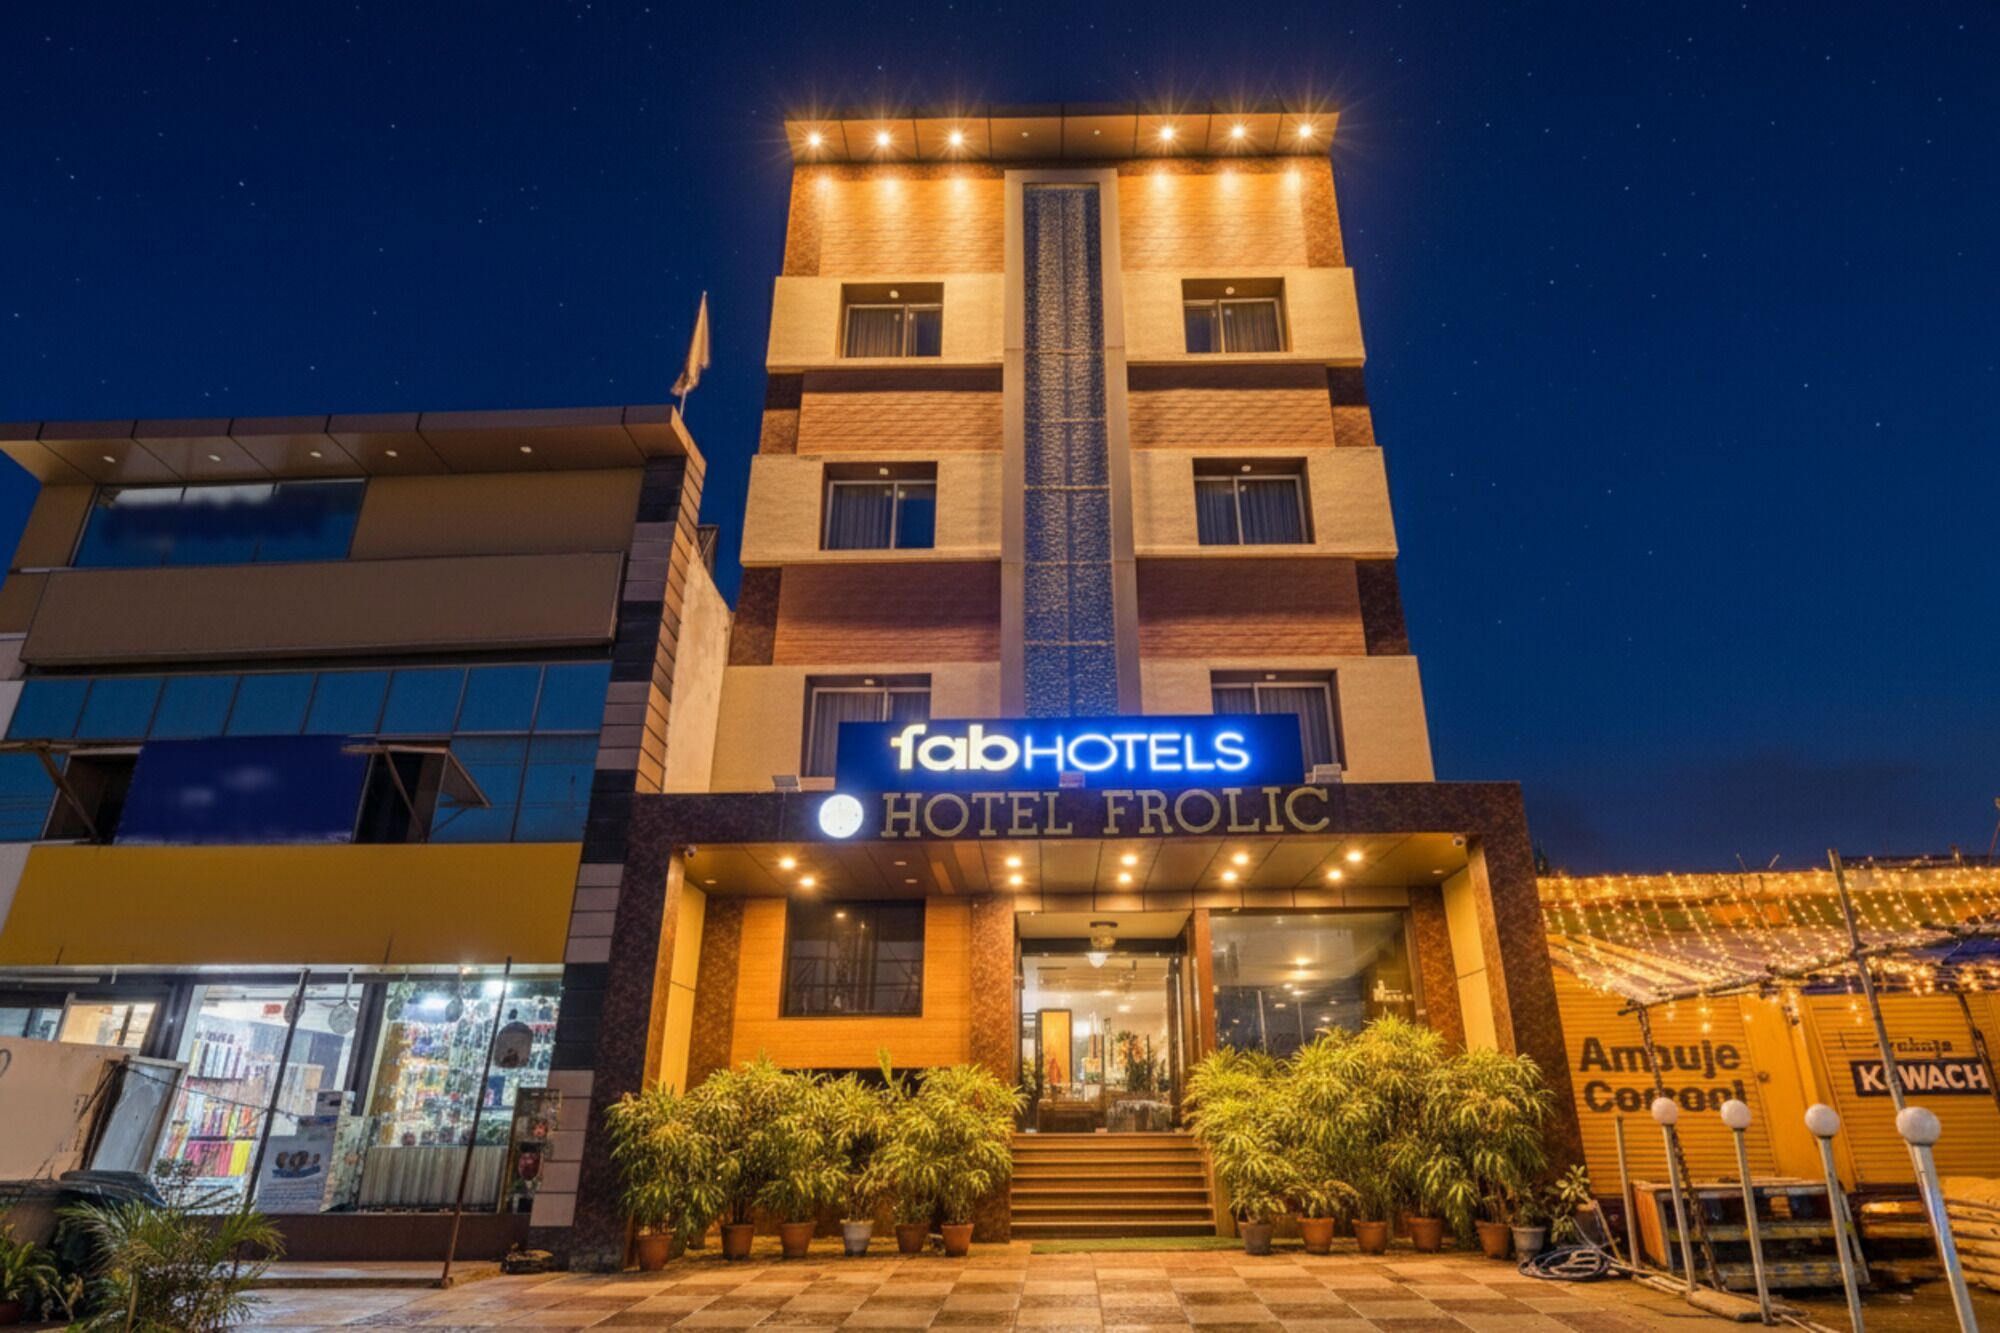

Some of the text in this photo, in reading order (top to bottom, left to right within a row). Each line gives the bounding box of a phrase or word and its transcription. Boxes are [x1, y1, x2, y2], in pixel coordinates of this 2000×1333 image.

[880, 786, 1331, 838] HOTEL FROLIC
[1858, 1063, 1990, 1091] KWACH
